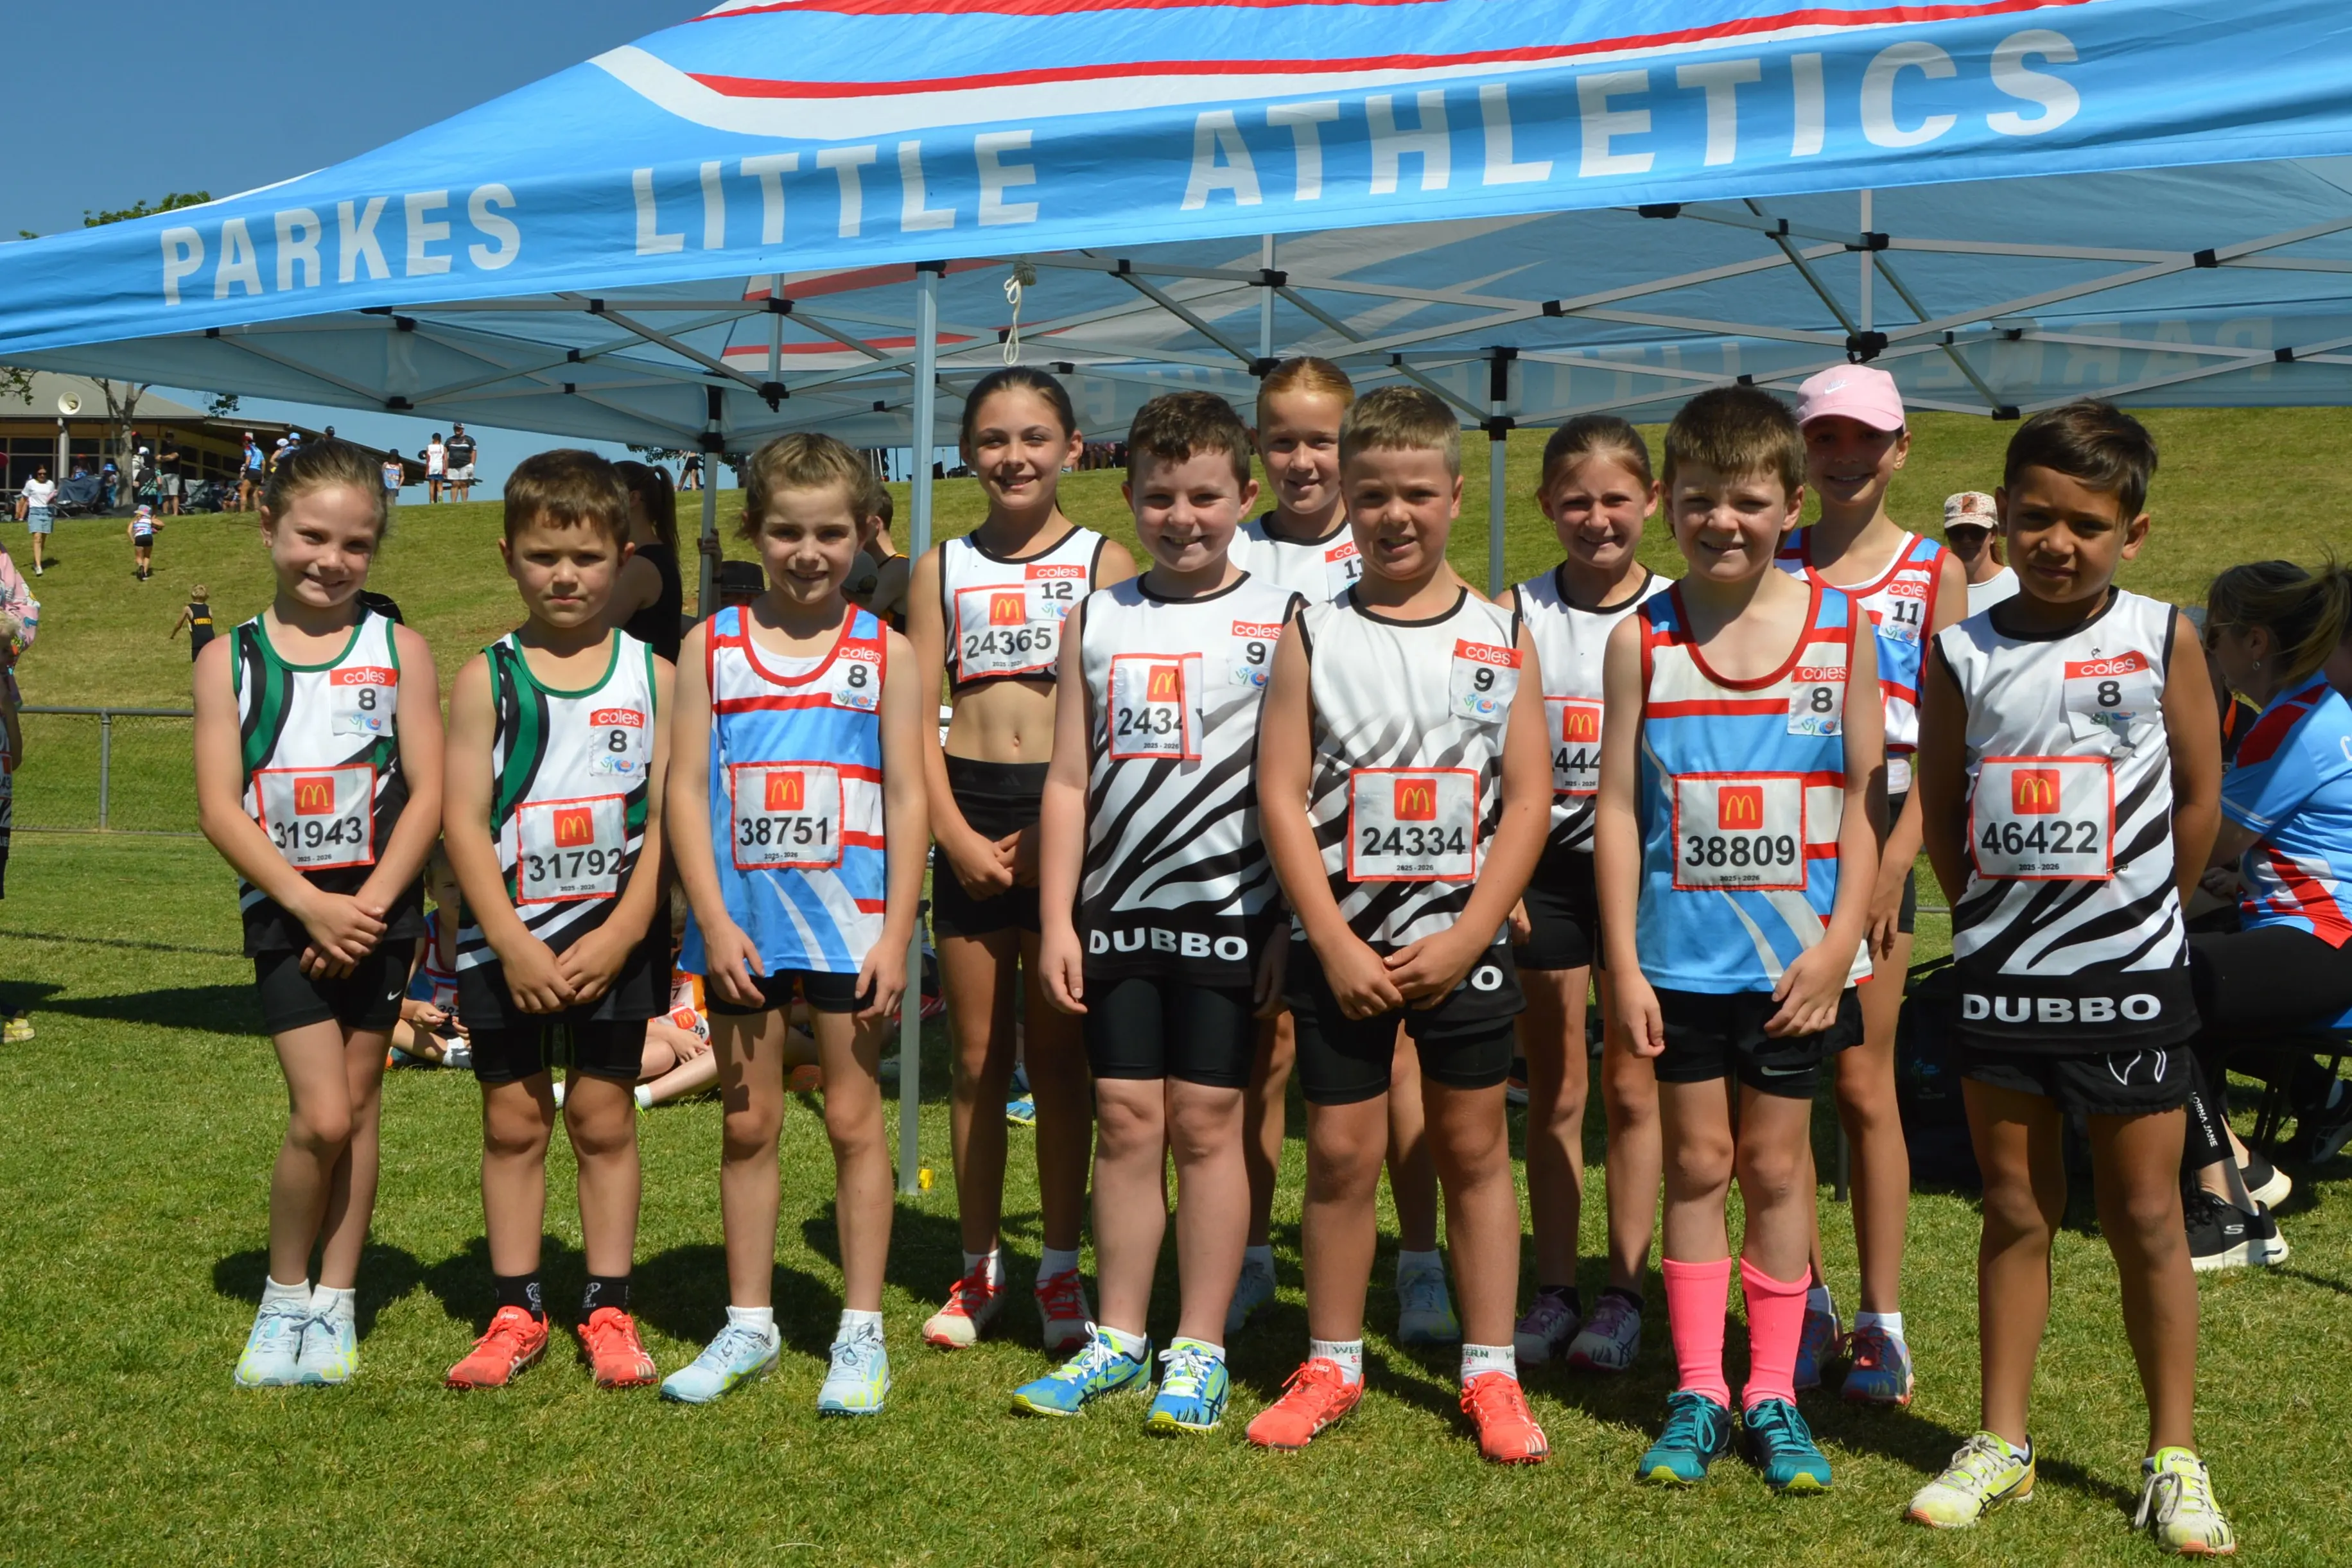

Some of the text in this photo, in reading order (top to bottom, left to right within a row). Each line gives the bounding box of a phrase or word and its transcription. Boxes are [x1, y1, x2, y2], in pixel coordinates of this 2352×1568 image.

[161, 29, 2081, 306] PARKES LITTLE ATHLETICS
[1036, 566, 1079, 577] coles
[1041, 581, 1073, 600] 12
[1892, 600, 1919, 625] 11
[965, 627, 1051, 659] 24365
[1233, 624, 1282, 639] coles
[839, 647, 881, 665] coles
[1246, 642, 1266, 665] 9
[1465, 645, 1511, 665] coles
[343, 668, 385, 684] coles
[848, 664, 867, 688] 8
[1802, 666, 1846, 681] coles
[2080, 658, 2136, 675] coles
[1473, 667, 1495, 692] 9
[358, 688, 376, 711] 8
[1810, 686, 1833, 713] 8
[2097, 680, 2121, 707] 8
[598, 710, 640, 726] coles
[608, 729, 627, 753] 8
[274, 816, 363, 849] 31943
[739, 816, 828, 847] 38751
[1361, 826, 1466, 857] 24334
[1981, 820, 2098, 855] 46422
[1685, 835, 1795, 867] 38809
[528, 847, 623, 883] 31792
[1088, 927, 1248, 961] DUBBO
[1962, 993, 2162, 1023] DUBBO
